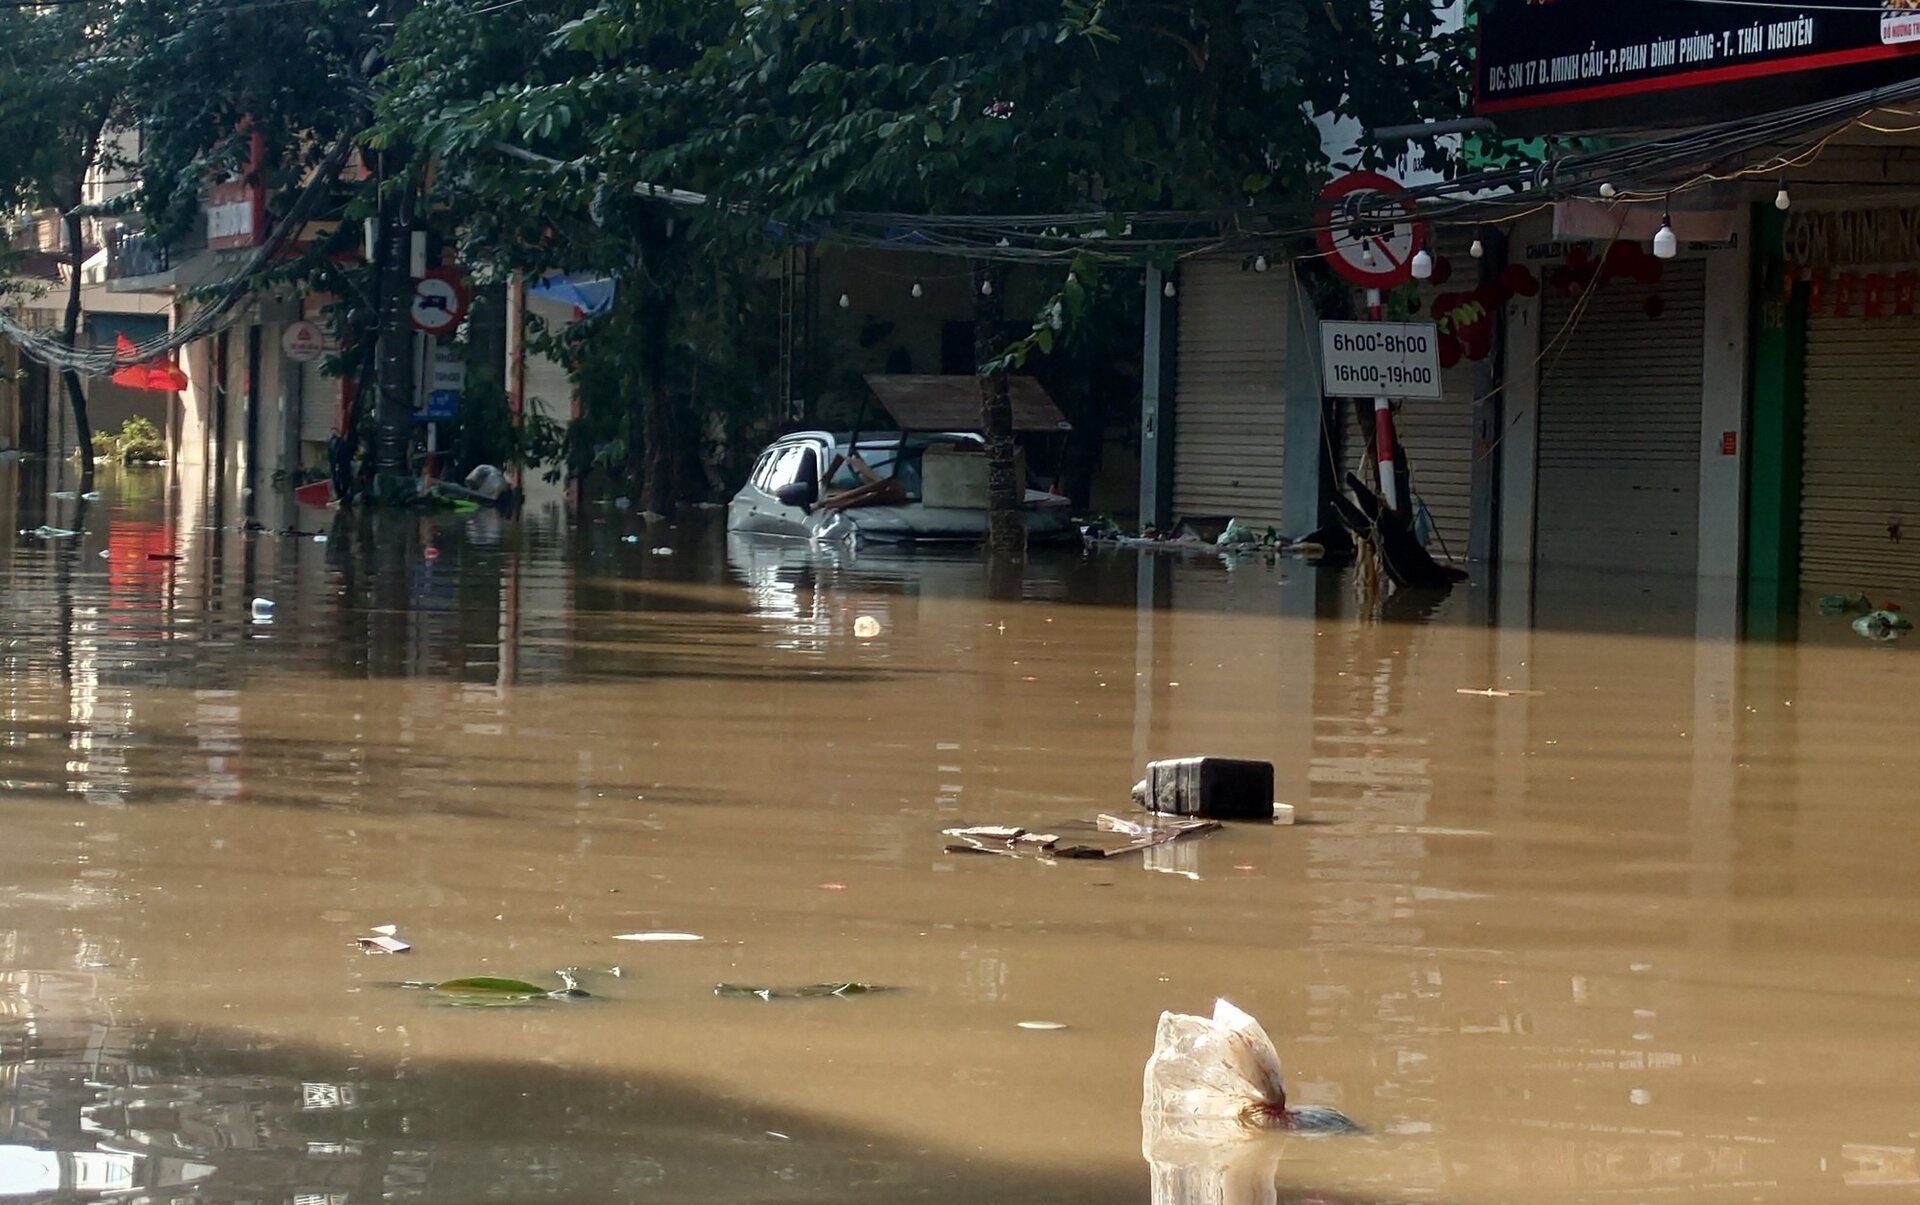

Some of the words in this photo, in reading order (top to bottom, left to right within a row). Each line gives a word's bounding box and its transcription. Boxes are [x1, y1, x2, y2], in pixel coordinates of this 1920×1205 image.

[1508, 63, 1523, 89] SN
[1525, 60, 1537, 86] 17
[1650, 36, 1676, 68] ĐÌNH
[1738, 21, 1764, 55] THÁI
[1767, 13, 1814, 51] NGUYÊN
[1333, 333, 1427, 353] 6h00-8h00
[1334, 364, 1431, 384] 16h00-19h00
